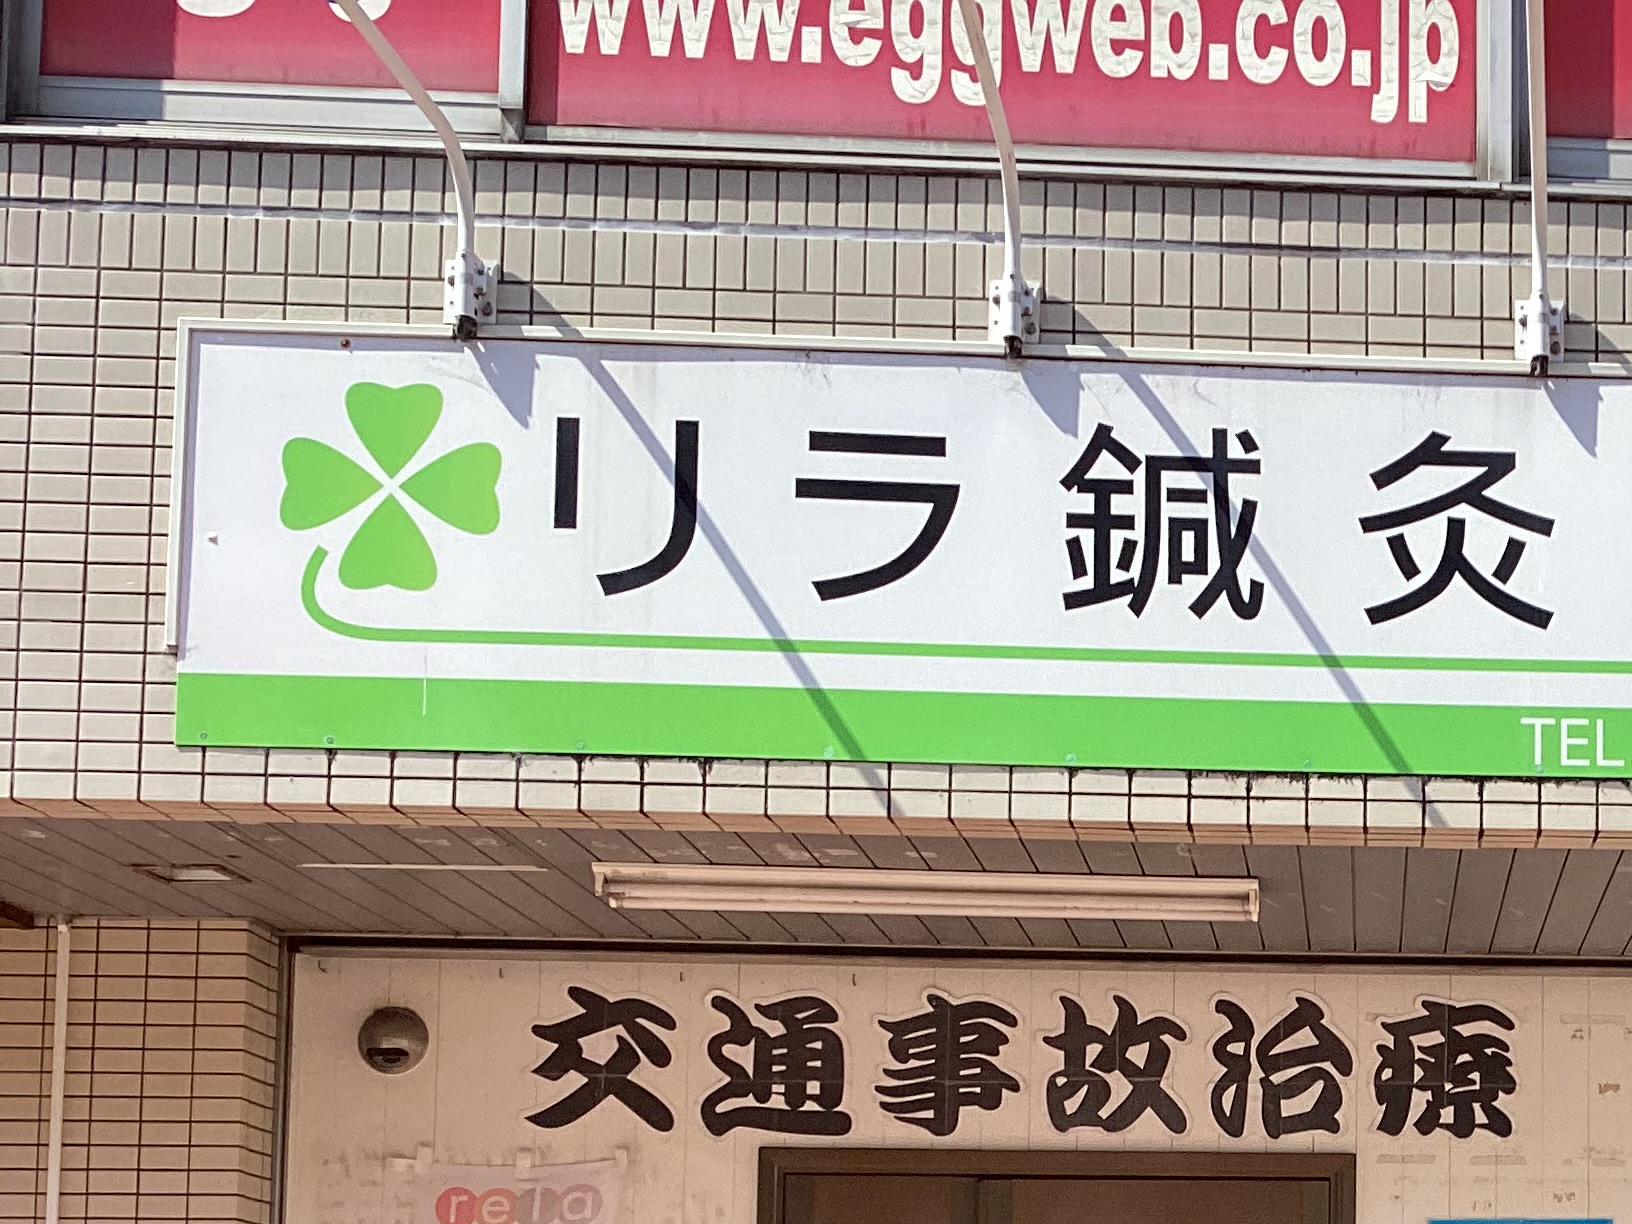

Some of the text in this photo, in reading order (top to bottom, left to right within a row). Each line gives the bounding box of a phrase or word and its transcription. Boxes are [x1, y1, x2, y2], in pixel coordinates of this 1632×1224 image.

[525, 985, 1519, 1139] 交通事故治療
